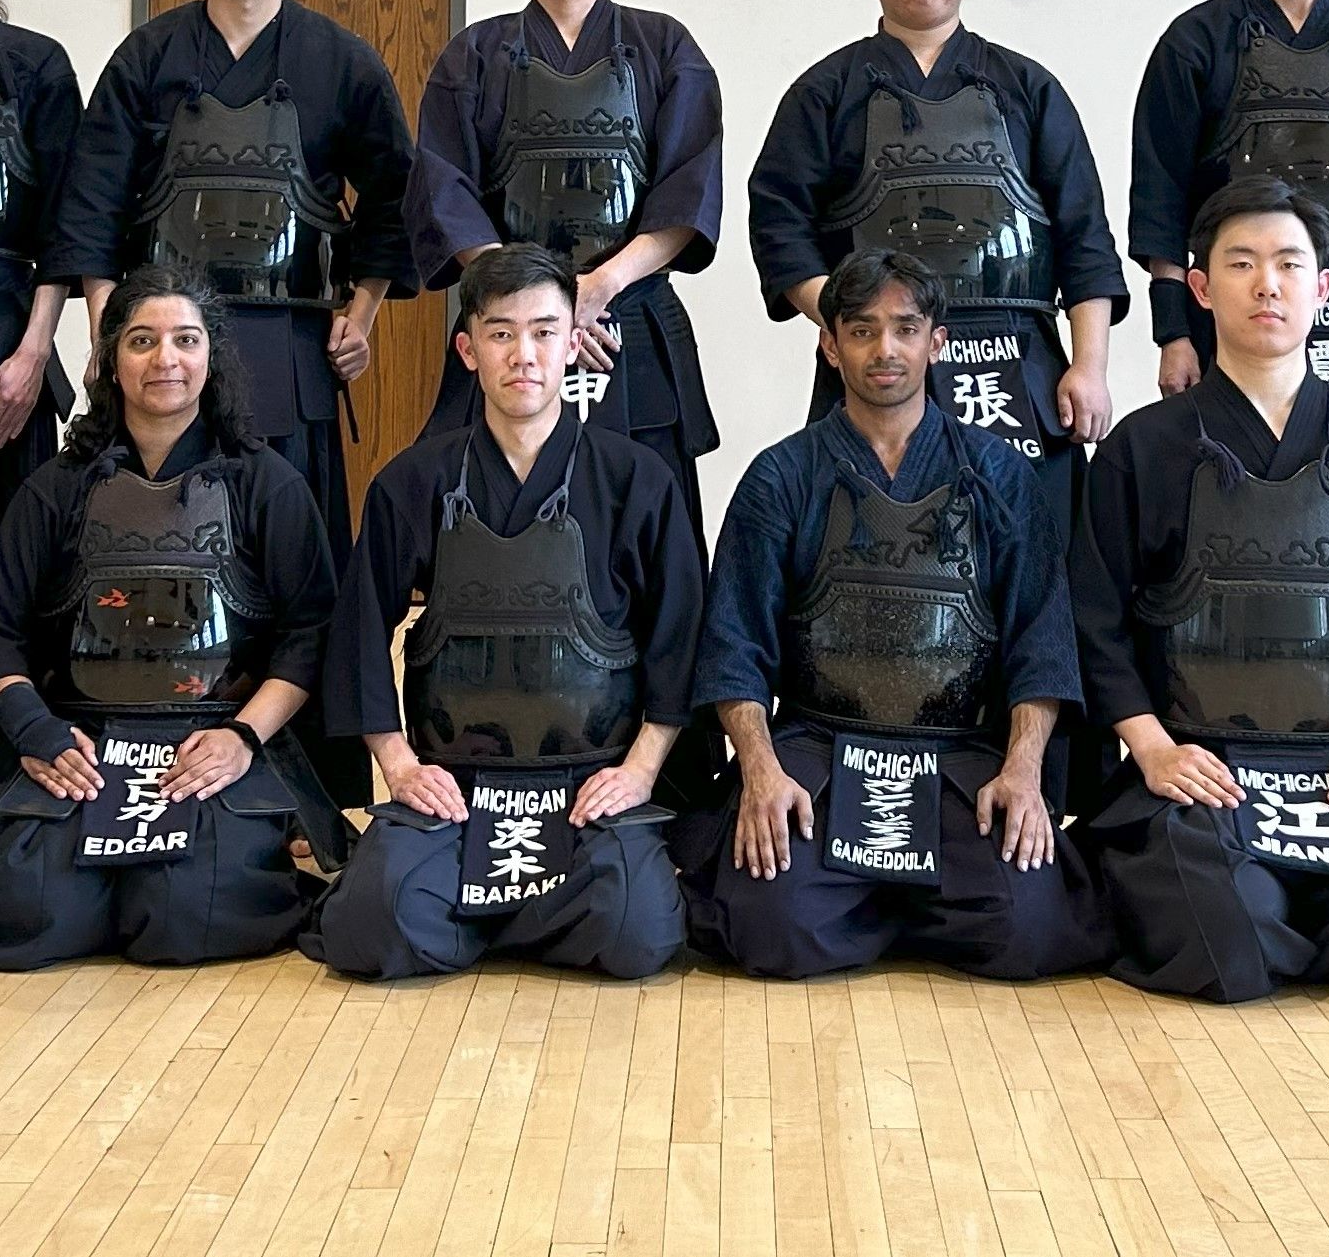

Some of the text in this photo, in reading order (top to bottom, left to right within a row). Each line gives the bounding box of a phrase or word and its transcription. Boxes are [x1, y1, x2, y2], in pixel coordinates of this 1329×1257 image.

[953, 372, 1022, 428] 張
[103, 739, 178, 767] MICHIG
[842, 745, 938, 779] MICHIGAN
[472, 786, 566, 816] MICHIGAN
[83, 831, 188, 856] EDGAR
[486, 817, 547, 883] 茨木
[831, 838, 935, 872] GANGEDDULA
